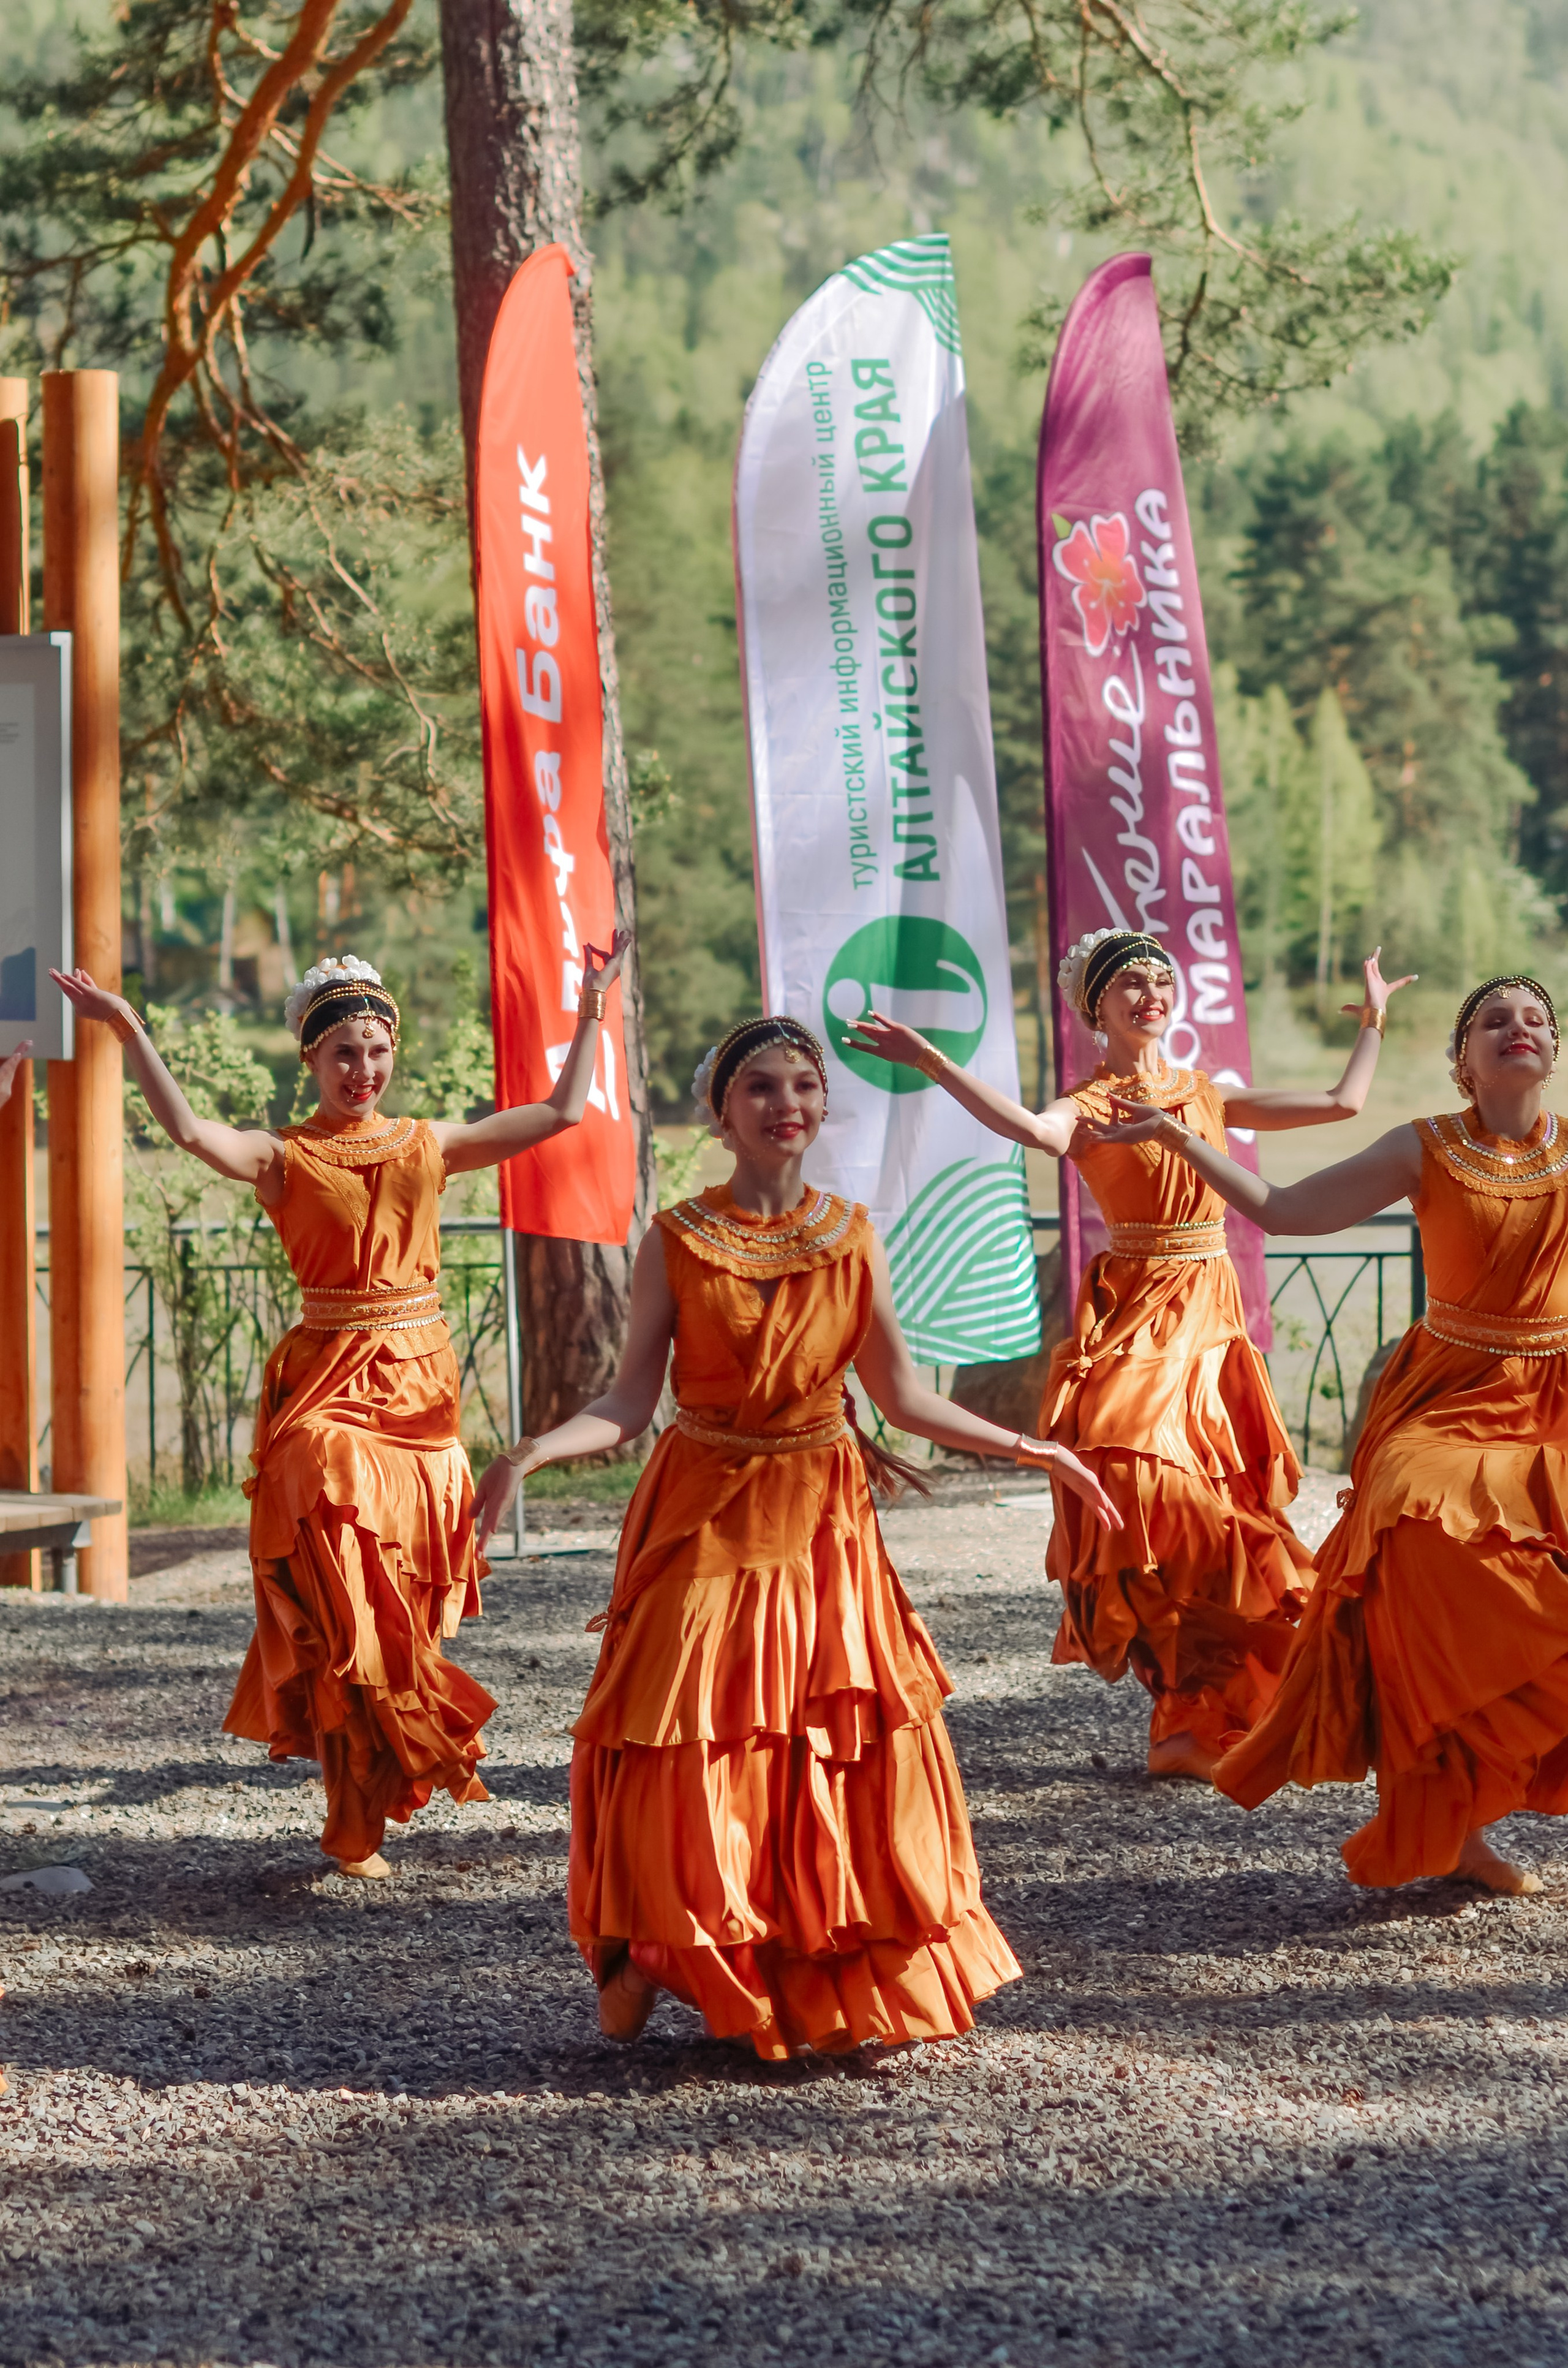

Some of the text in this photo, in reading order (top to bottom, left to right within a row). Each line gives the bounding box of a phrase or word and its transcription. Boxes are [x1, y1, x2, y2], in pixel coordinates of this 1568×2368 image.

[516, 443, 563, 724] Банк
[805, 360, 878, 890] туристский информационный центр
[850, 358, 940, 881] АЛТАЙСКОГО КРАЯ
[1134, 488, 1235, 1025] МАРАЛЬНИКА
